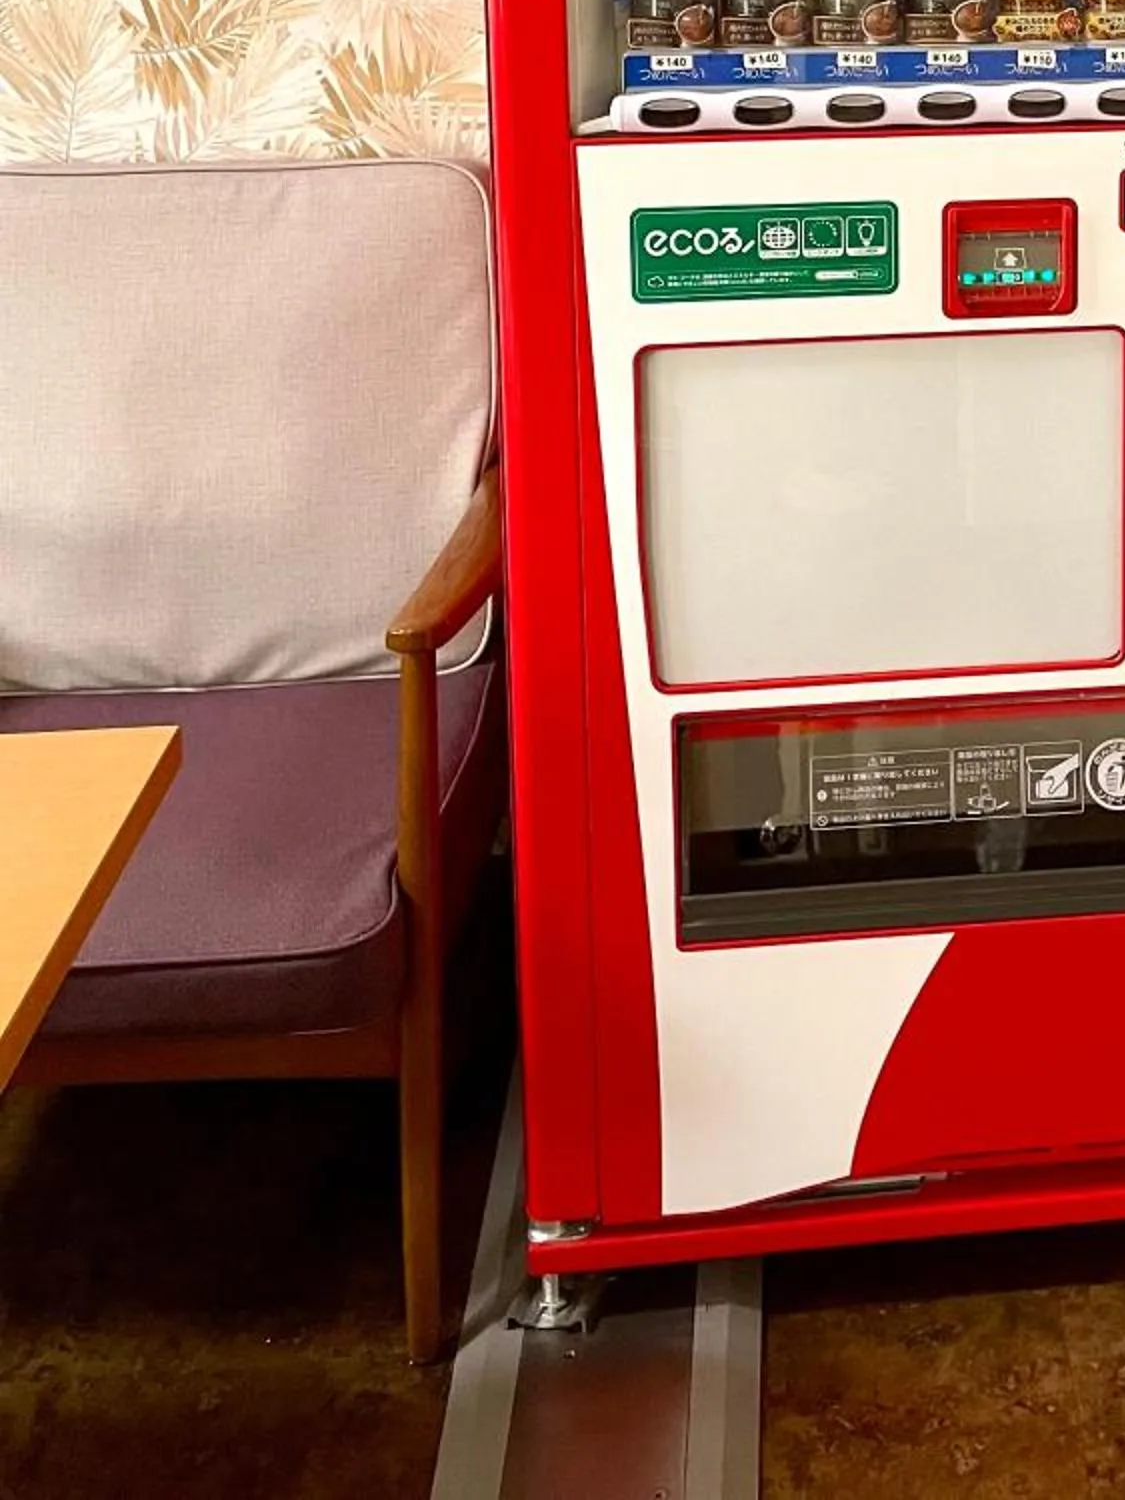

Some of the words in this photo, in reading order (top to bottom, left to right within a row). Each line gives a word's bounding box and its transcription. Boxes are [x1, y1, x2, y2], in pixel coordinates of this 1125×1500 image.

[656, 58, 687, 67] ¥140
[749, 54, 779, 64] ¥140
[843, 55, 873, 64] ¥140
[933, 54, 962, 63] ¥140
